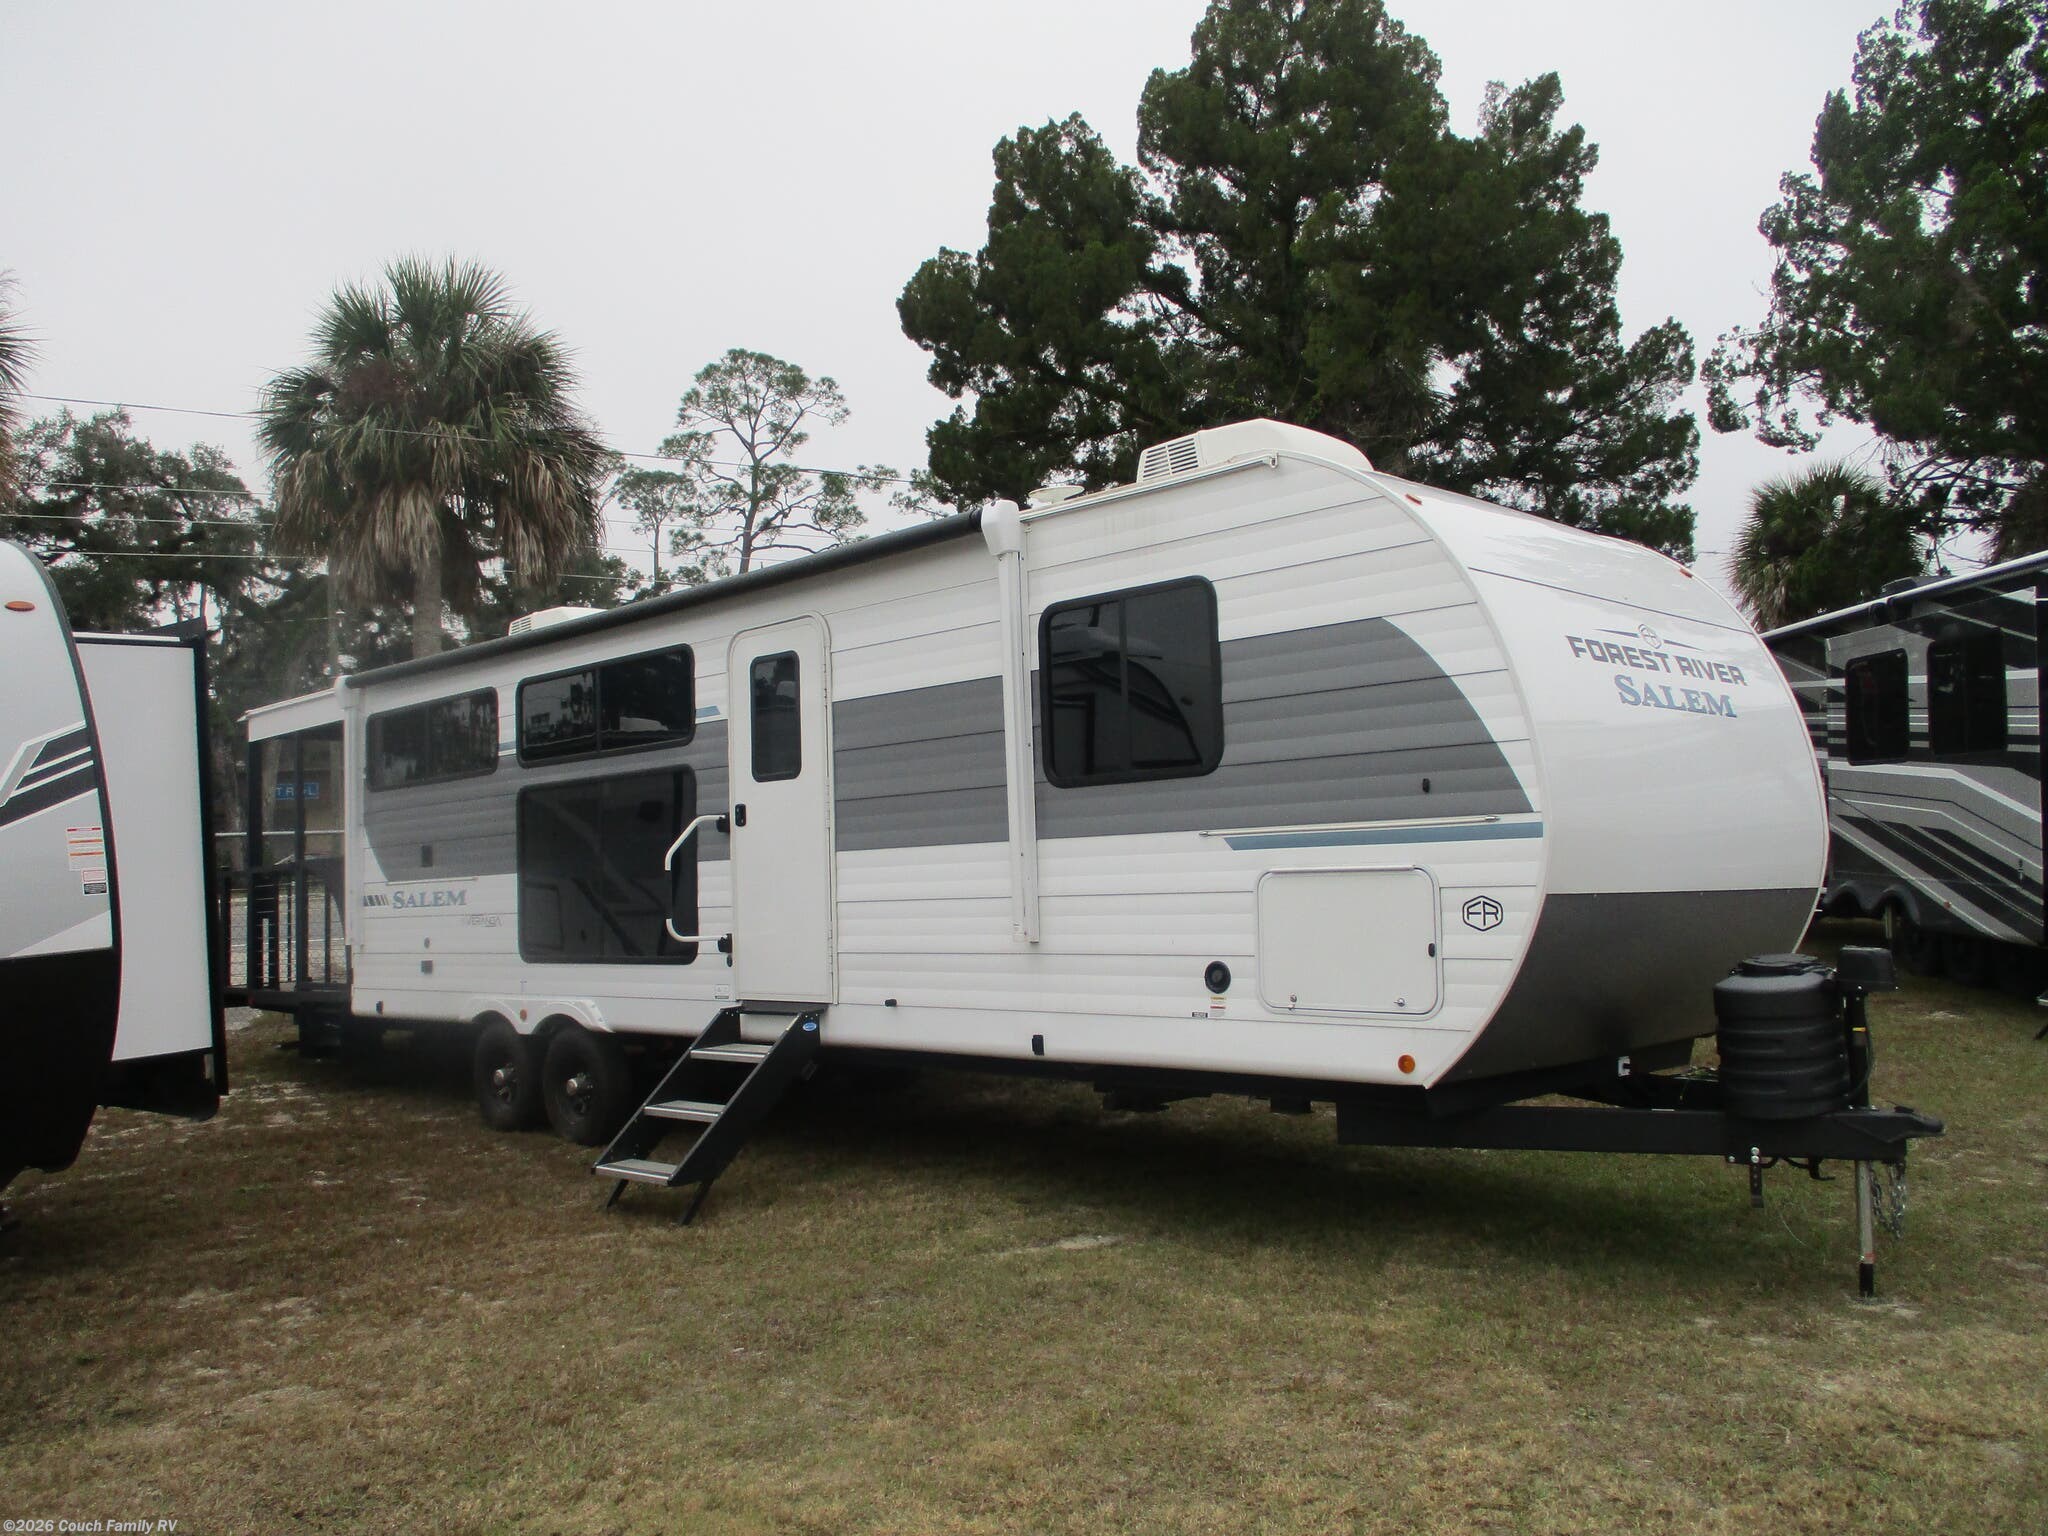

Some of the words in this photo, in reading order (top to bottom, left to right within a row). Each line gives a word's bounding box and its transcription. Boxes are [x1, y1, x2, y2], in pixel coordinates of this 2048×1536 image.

[1566, 636, 1672, 673] FOREST
[1673, 654, 1748, 686] RIVER
[1614, 674, 1737, 718] SALEM
[393, 890, 467, 909] SALEM
